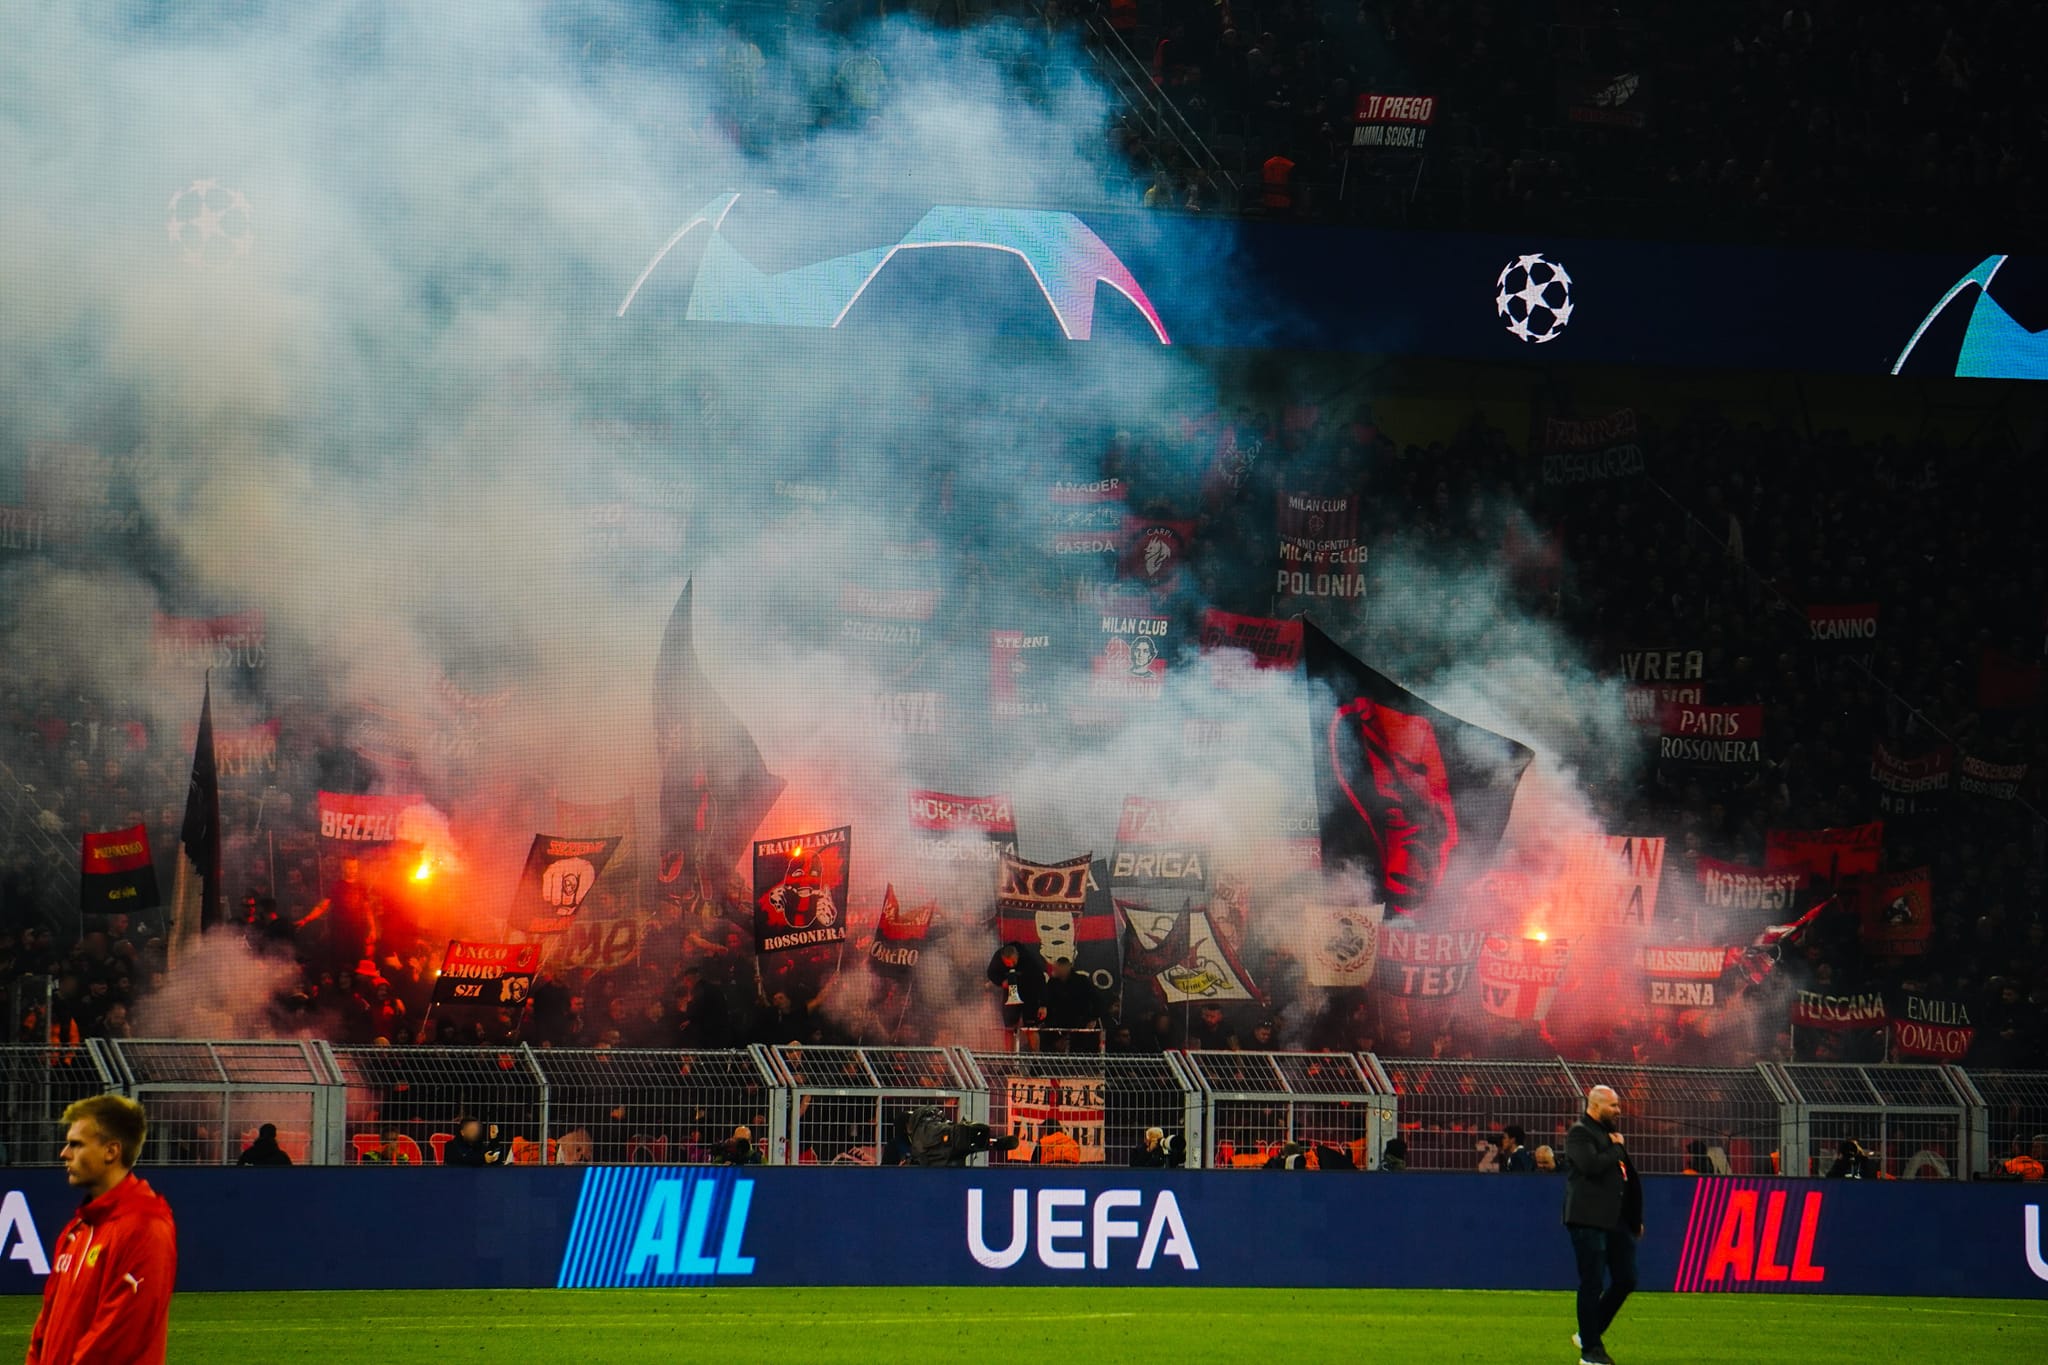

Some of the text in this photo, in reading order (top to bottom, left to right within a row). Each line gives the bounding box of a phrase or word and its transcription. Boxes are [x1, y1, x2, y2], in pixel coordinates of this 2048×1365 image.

[1380, 96, 1433, 120] PREGO
[1384, 126, 1416, 147] SCUSA
[1288, 496, 1348, 513] MILAN CLUB
[1146, 529, 1173, 538] CARPI
[1279, 541, 1368, 564] MILAN CLUB
[1276, 570, 1368, 597] POLONIA
[1102, 616, 1168, 637] MILAN CLUB
[1809, 617, 1877, 641] SCANNO
[995, 636, 1049, 649] ETERNI
[1619, 650, 1705, 683] IVREA
[1680, 709, 1740, 735] PARIS
[1660, 736, 1761, 763] ROSSONERA
[910, 797, 1011, 825] MORTARA
[758, 829, 846, 857] FRATELLANZA
[1113, 852, 1203, 880] BRIGA
[1003, 864, 1088, 900] NOI
[1704, 868, 1801, 911] NORDEST
[453, 943, 508, 961] UNICO
[763, 927, 847, 953] ROSSONERA
[443, 963, 507, 980] AMORE
[453, 983, 483, 998] SEI
[1651, 981, 1716, 1006] ELENA
[1796, 989, 1886, 1024] TOSCANA
[1907, 996, 1972, 1026] EMILIA
[1011, 1083, 1105, 1108] ULTRAS
[625, 1179, 756, 1276] ALL
[967, 1188, 1200, 1271] UEFA
[1704, 1189, 1826, 1283] ALL
